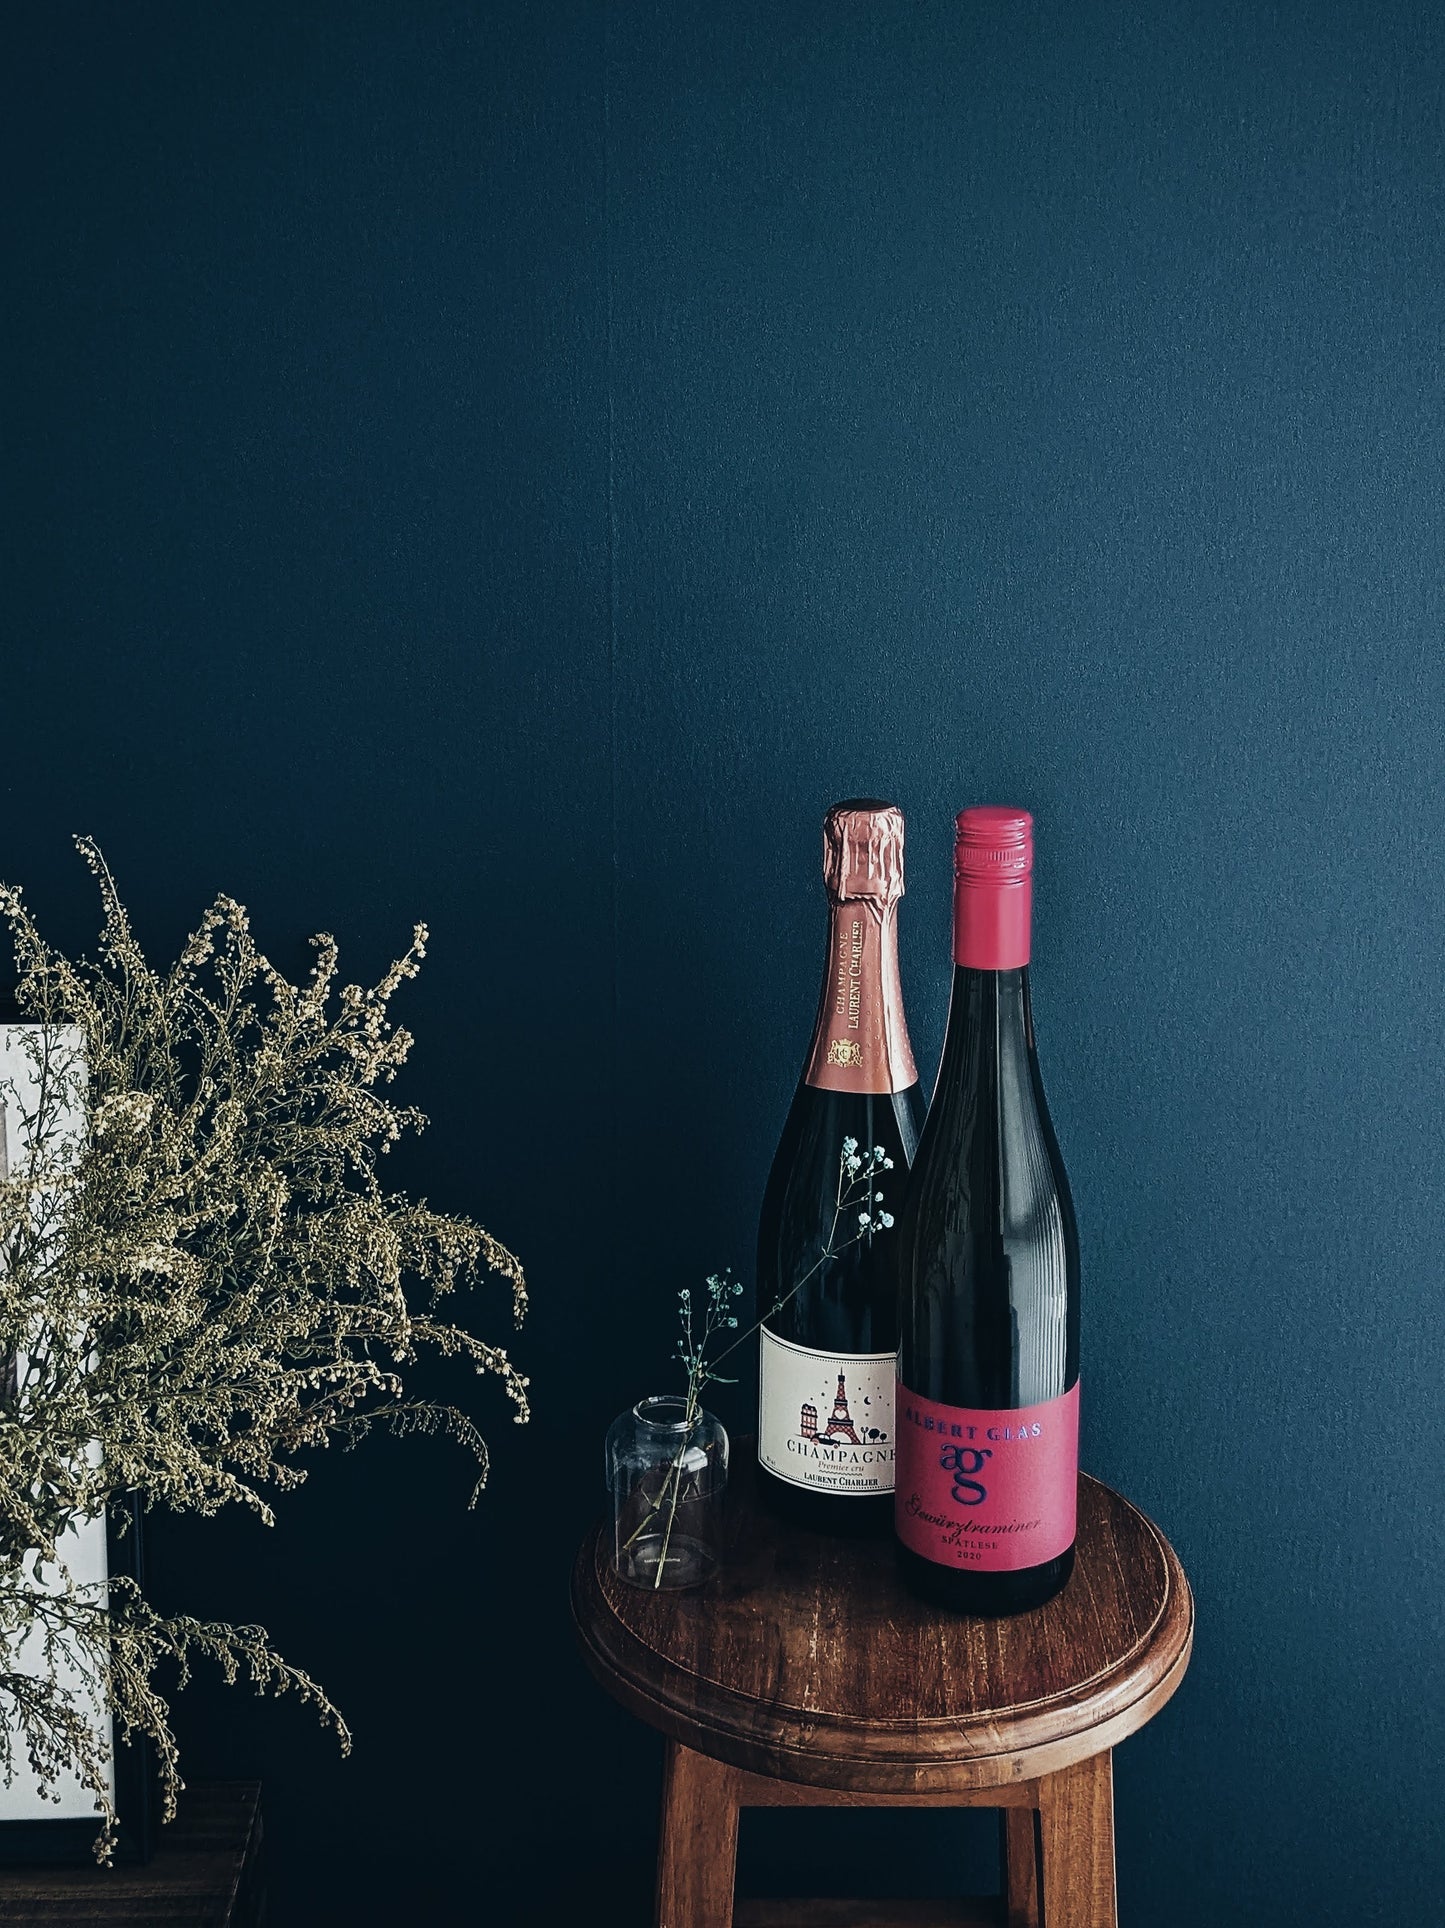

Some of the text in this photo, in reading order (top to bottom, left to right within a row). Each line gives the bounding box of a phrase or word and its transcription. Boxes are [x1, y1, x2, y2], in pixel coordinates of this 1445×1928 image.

[836, 932, 848, 1014] CHAMPAGNE
[848, 920, 863, 1029] LAURENT CHARLIER
[905, 1407, 1042, 1441] ALBERT GLAS
[804, 1472, 878, 1486] LAURENT CHARLIER
[818, 1461, 865, 1472] Premier cru
[904, 1492, 1041, 1538] Gewürztraminer
[957, 1550, 982, 1561] 2020
